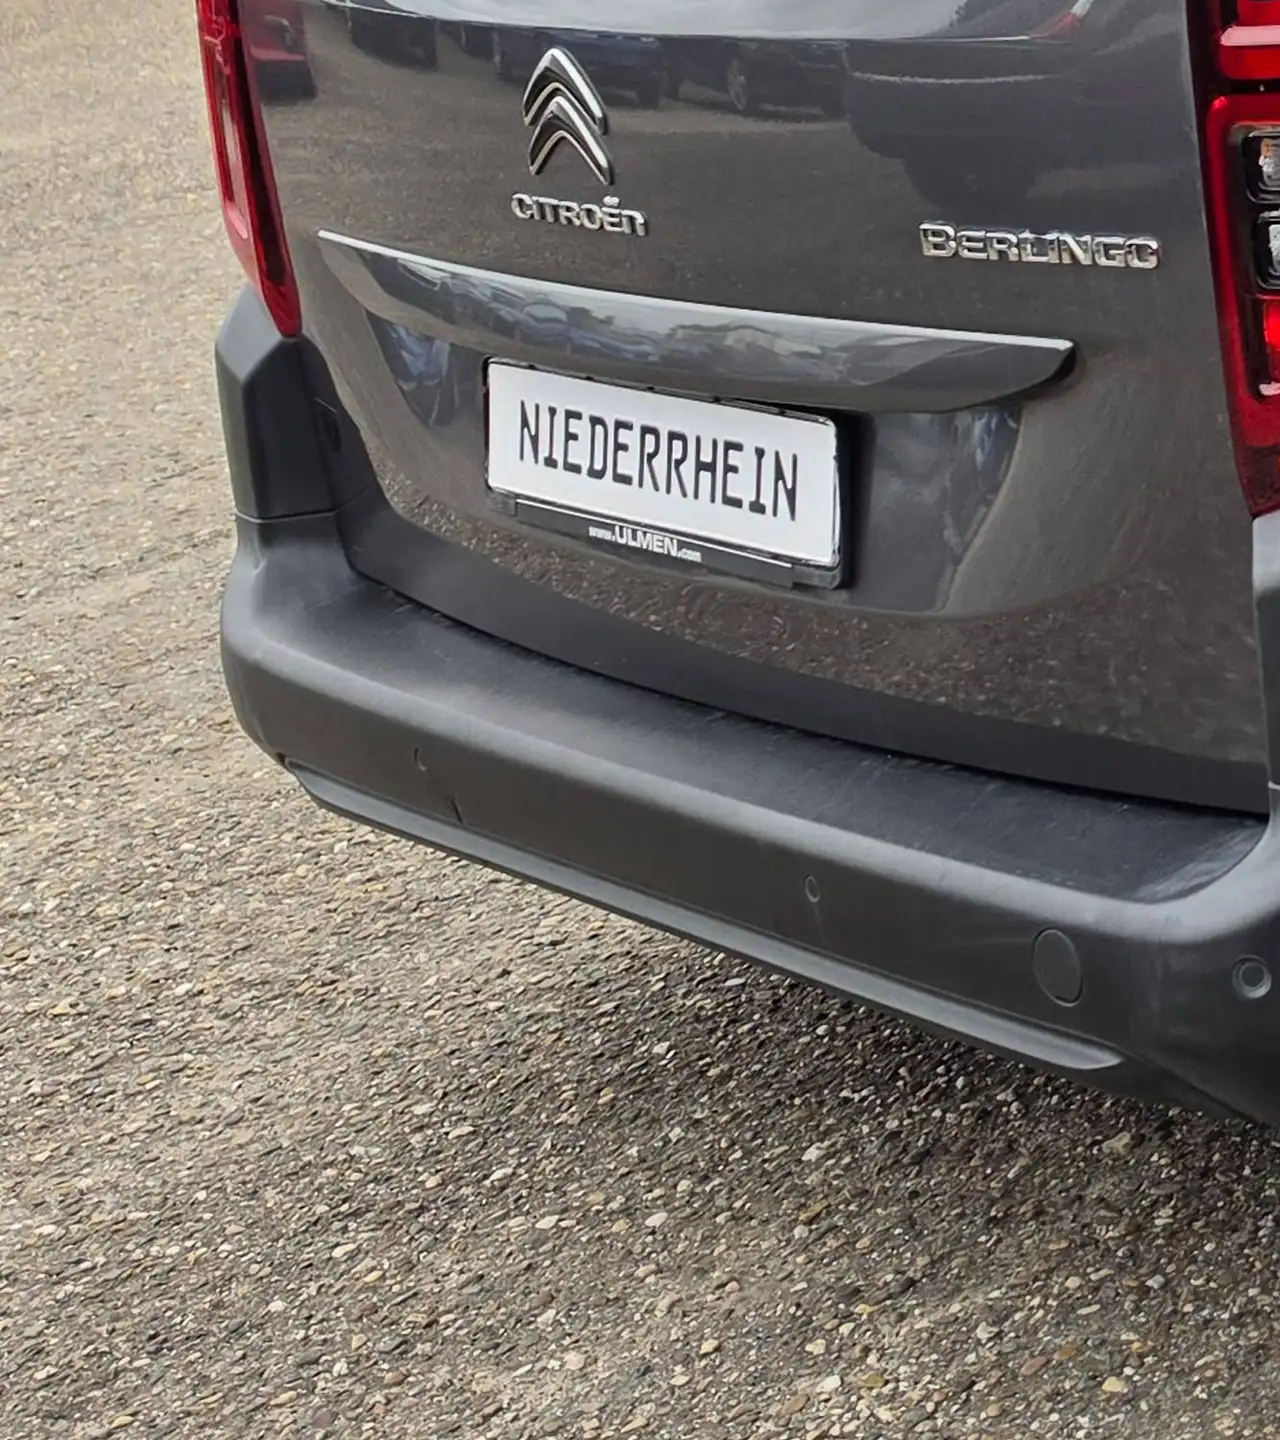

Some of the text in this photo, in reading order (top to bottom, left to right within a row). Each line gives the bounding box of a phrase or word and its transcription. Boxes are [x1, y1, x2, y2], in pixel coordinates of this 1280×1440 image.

[511, 193, 647, 236] CITROËN
[519, 399, 799, 522] NIEDERRHEIN
[588, 525, 702, 562] www.ULMEN.com
